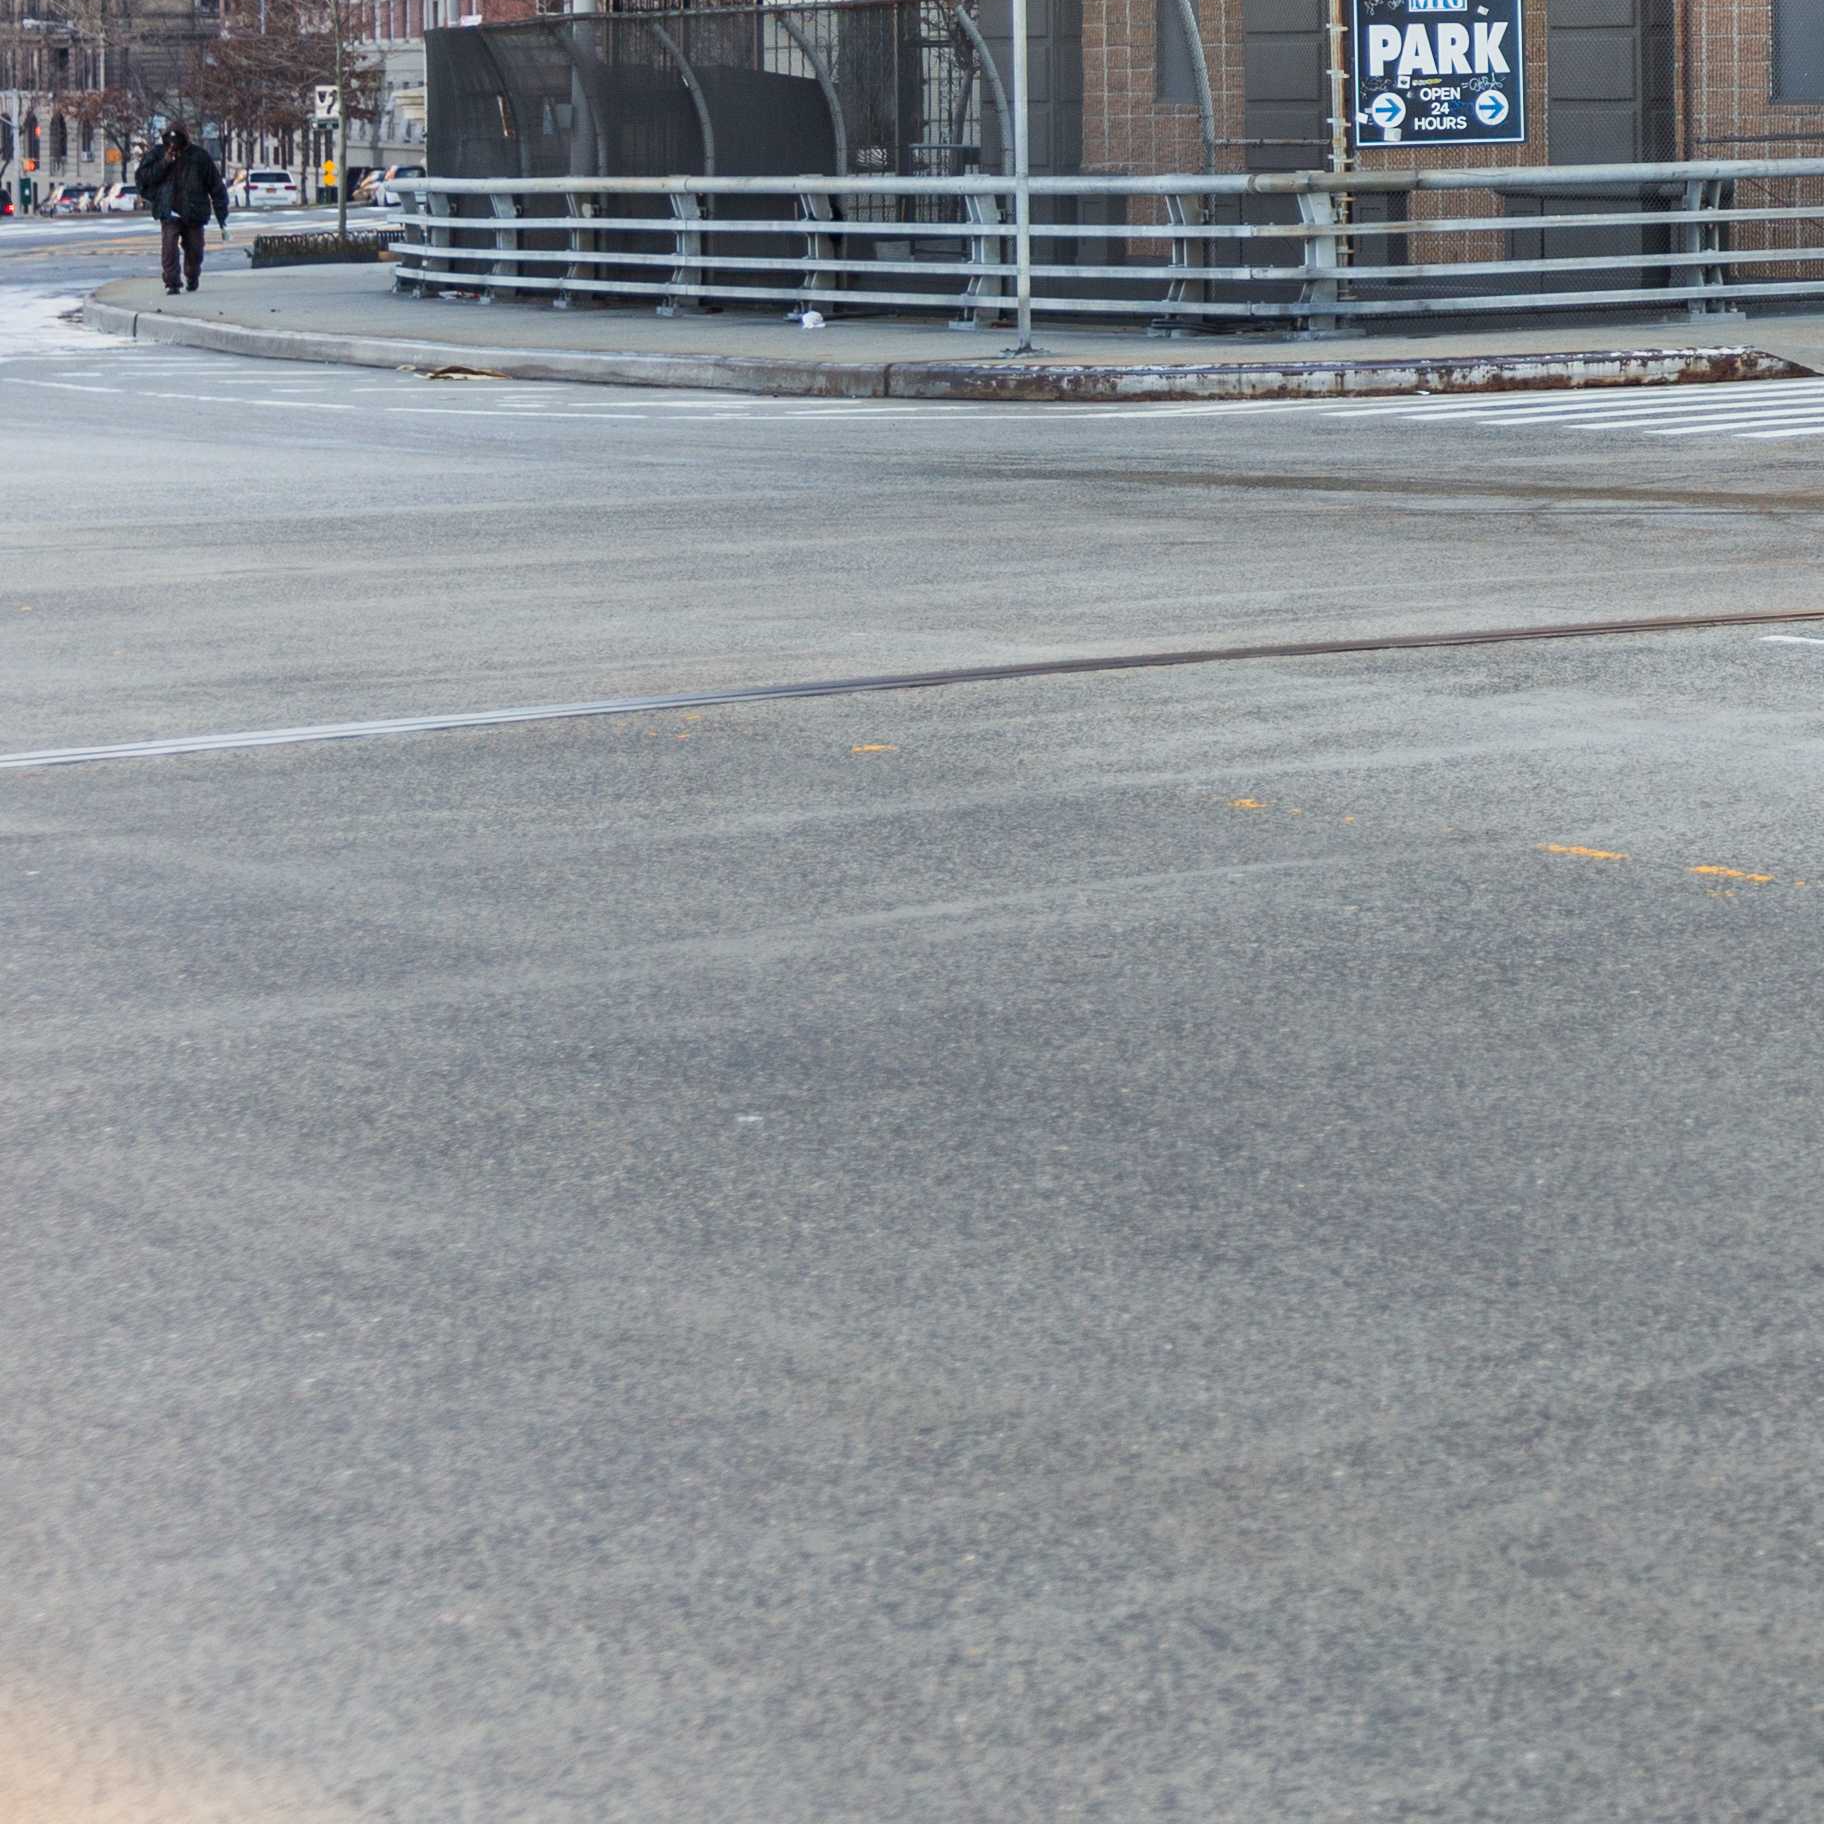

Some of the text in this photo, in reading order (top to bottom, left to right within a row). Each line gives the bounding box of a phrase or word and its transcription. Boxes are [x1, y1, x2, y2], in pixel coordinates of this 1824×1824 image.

[1368, 21, 1511, 77] PARK
[1419, 86, 1461, 102] OPEN
[1430, 101, 1450, 116] 24
[1413, 116, 1468, 131] HOURS
